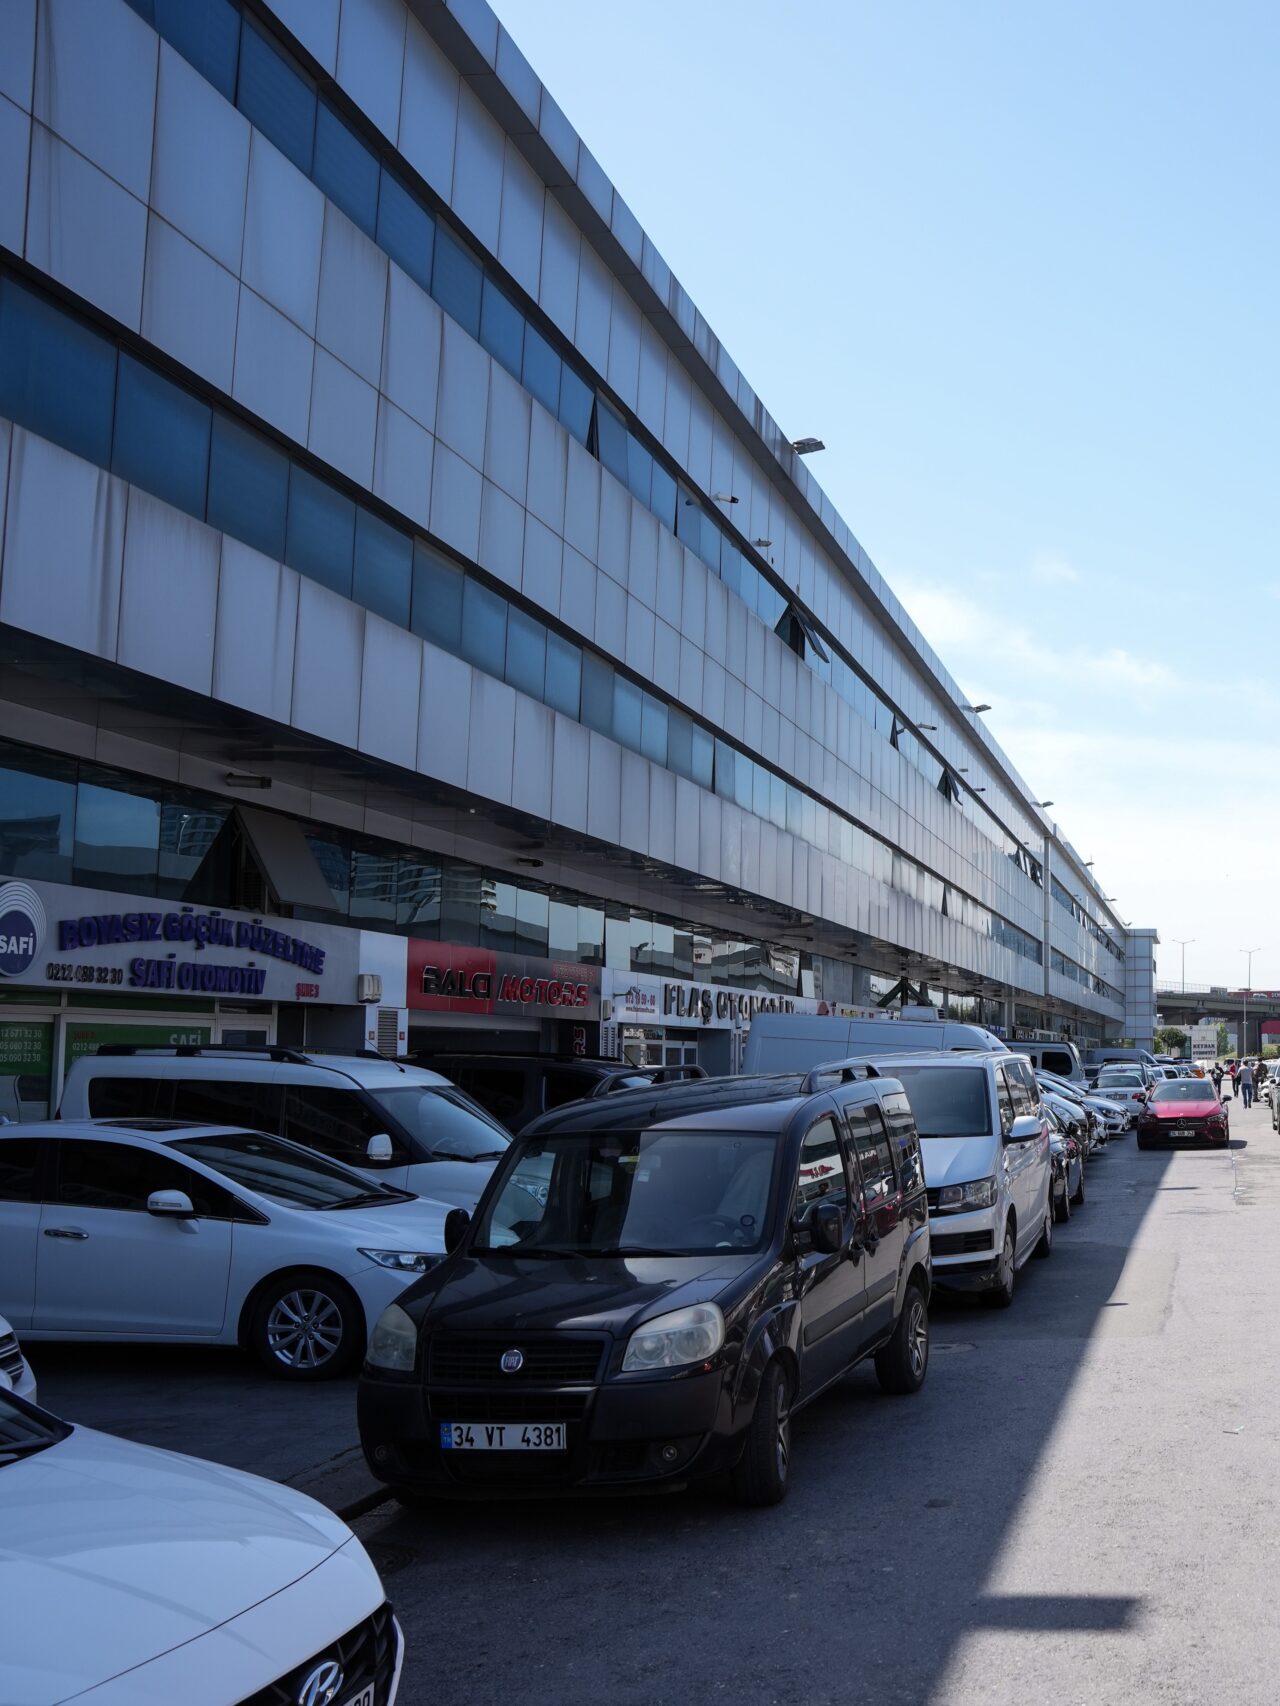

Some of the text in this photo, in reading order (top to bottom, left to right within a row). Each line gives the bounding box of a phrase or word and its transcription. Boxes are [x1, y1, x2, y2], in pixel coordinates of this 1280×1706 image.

[0, 932, 34, 956] SAFİ
[58, 906, 326, 975] BOYASIZ GÖÇÜK DÜZELTME
[47, 963, 73, 981] 0212
[95, 966, 108, 983] 32
[110, 968, 123, 985] 30
[129, 953, 267, 995] SAFİ OTOMOTİV
[498, 974, 590, 1009] MOTORS
[454, 1425, 475, 1447] 34
[485, 1426, 506, 1447] VT
[521, 1426, 561, 1447] 4381
